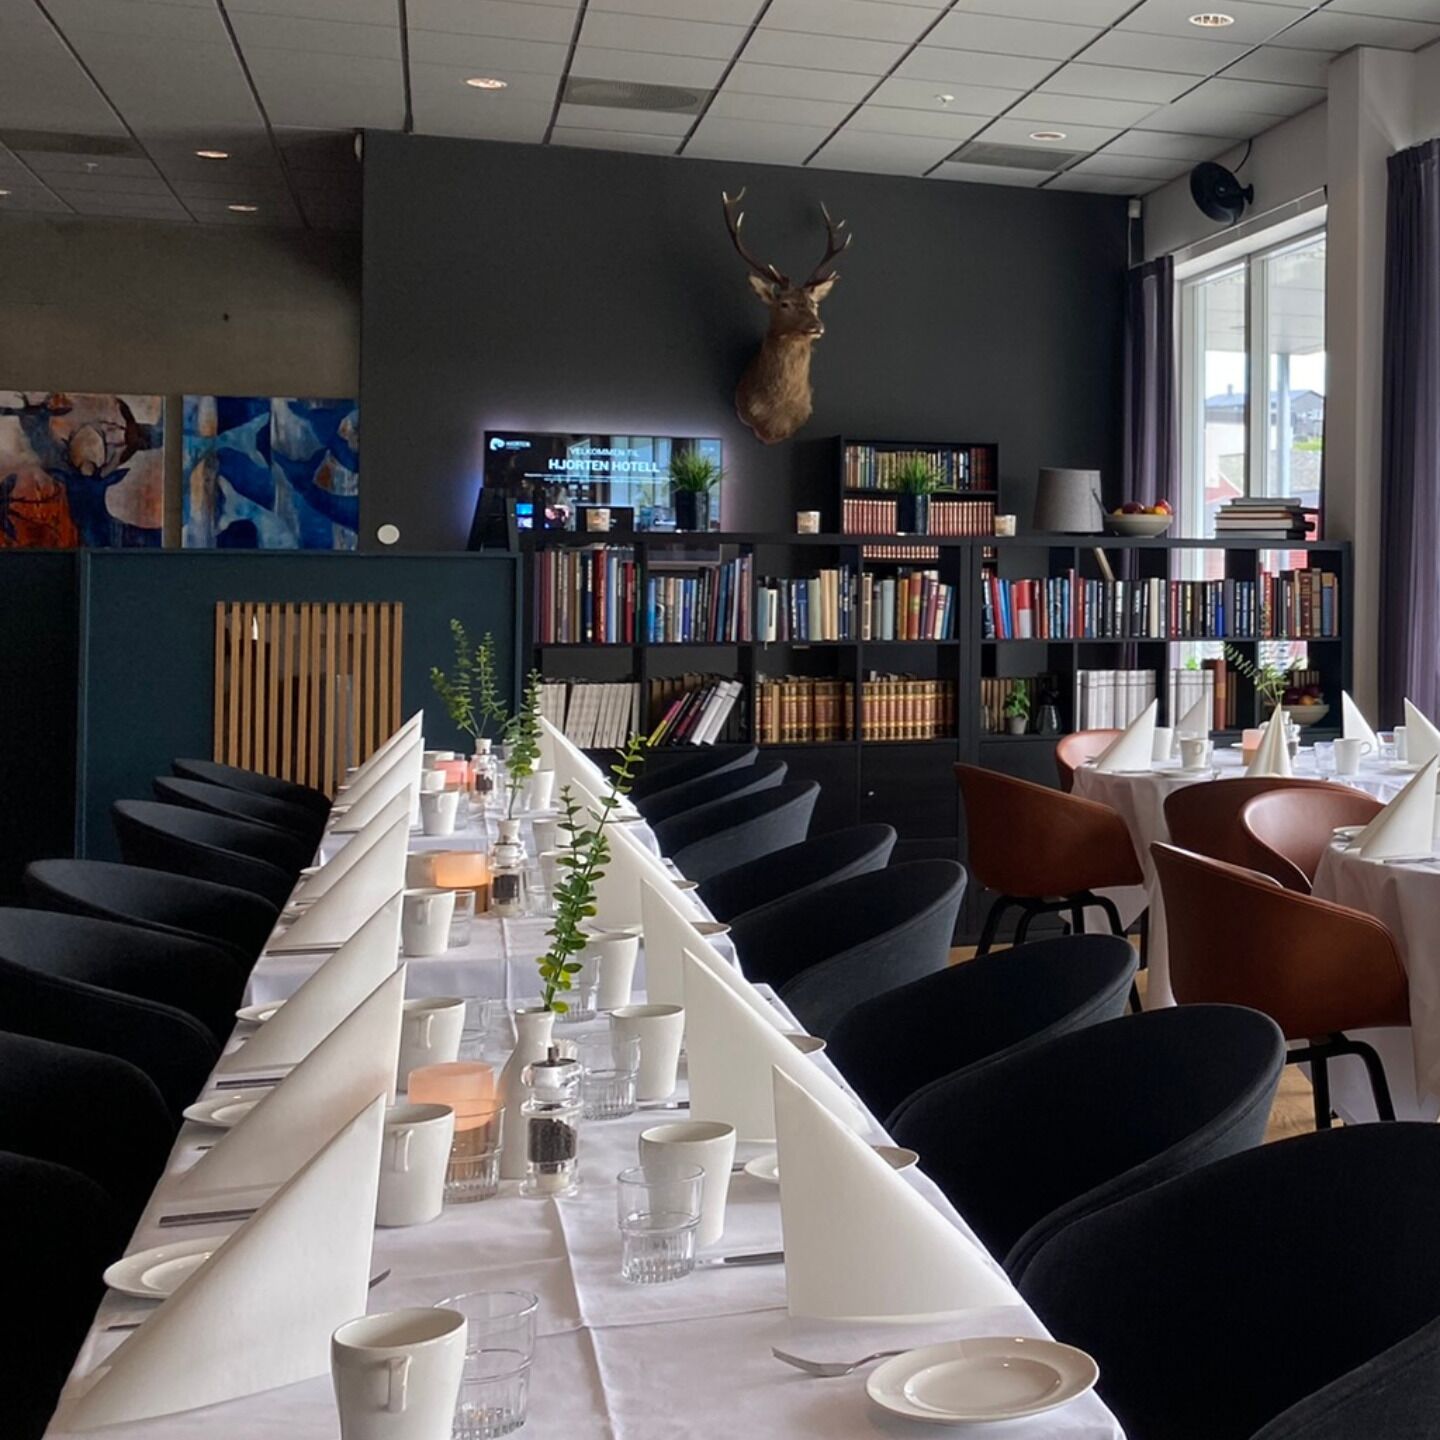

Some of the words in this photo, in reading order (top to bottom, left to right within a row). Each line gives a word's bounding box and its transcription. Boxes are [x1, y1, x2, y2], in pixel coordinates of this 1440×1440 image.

[570, 447, 624, 457] VELKOMMEN
[548, 457, 609, 471] HJORTEN
[611, 460, 661, 473] HOTELL
